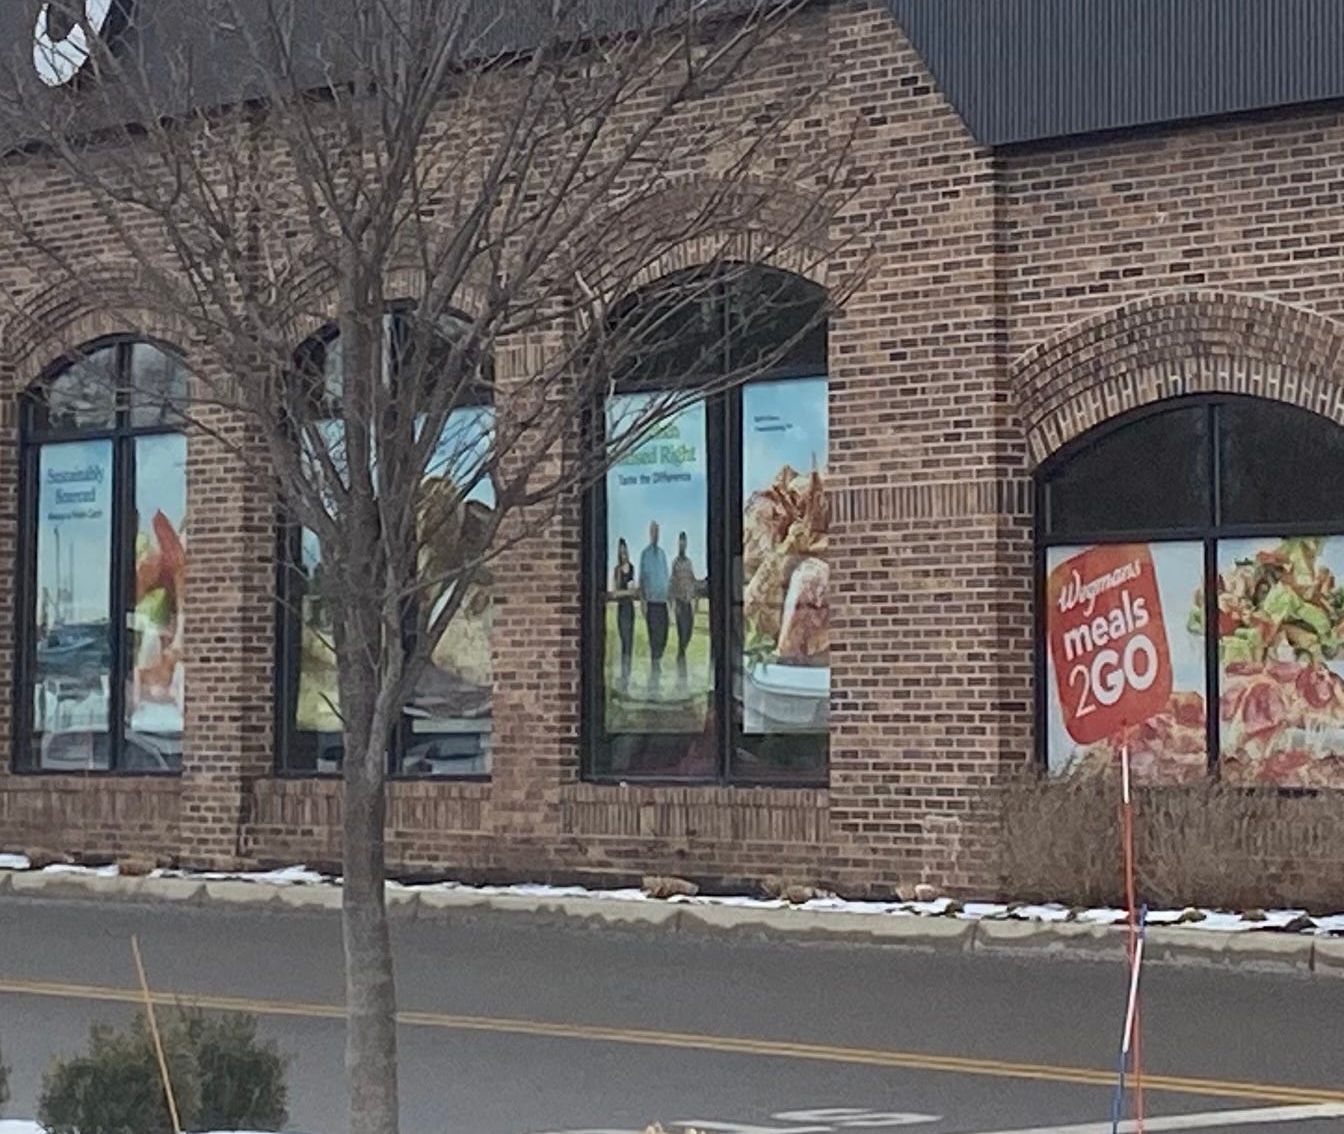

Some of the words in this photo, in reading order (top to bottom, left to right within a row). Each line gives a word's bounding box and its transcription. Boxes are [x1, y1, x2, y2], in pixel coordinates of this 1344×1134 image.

[1058, 558, 1142, 617] Wegmans
[1063, 589, 1150, 662] meals
[1068, 633, 1159, 719] 2GO
